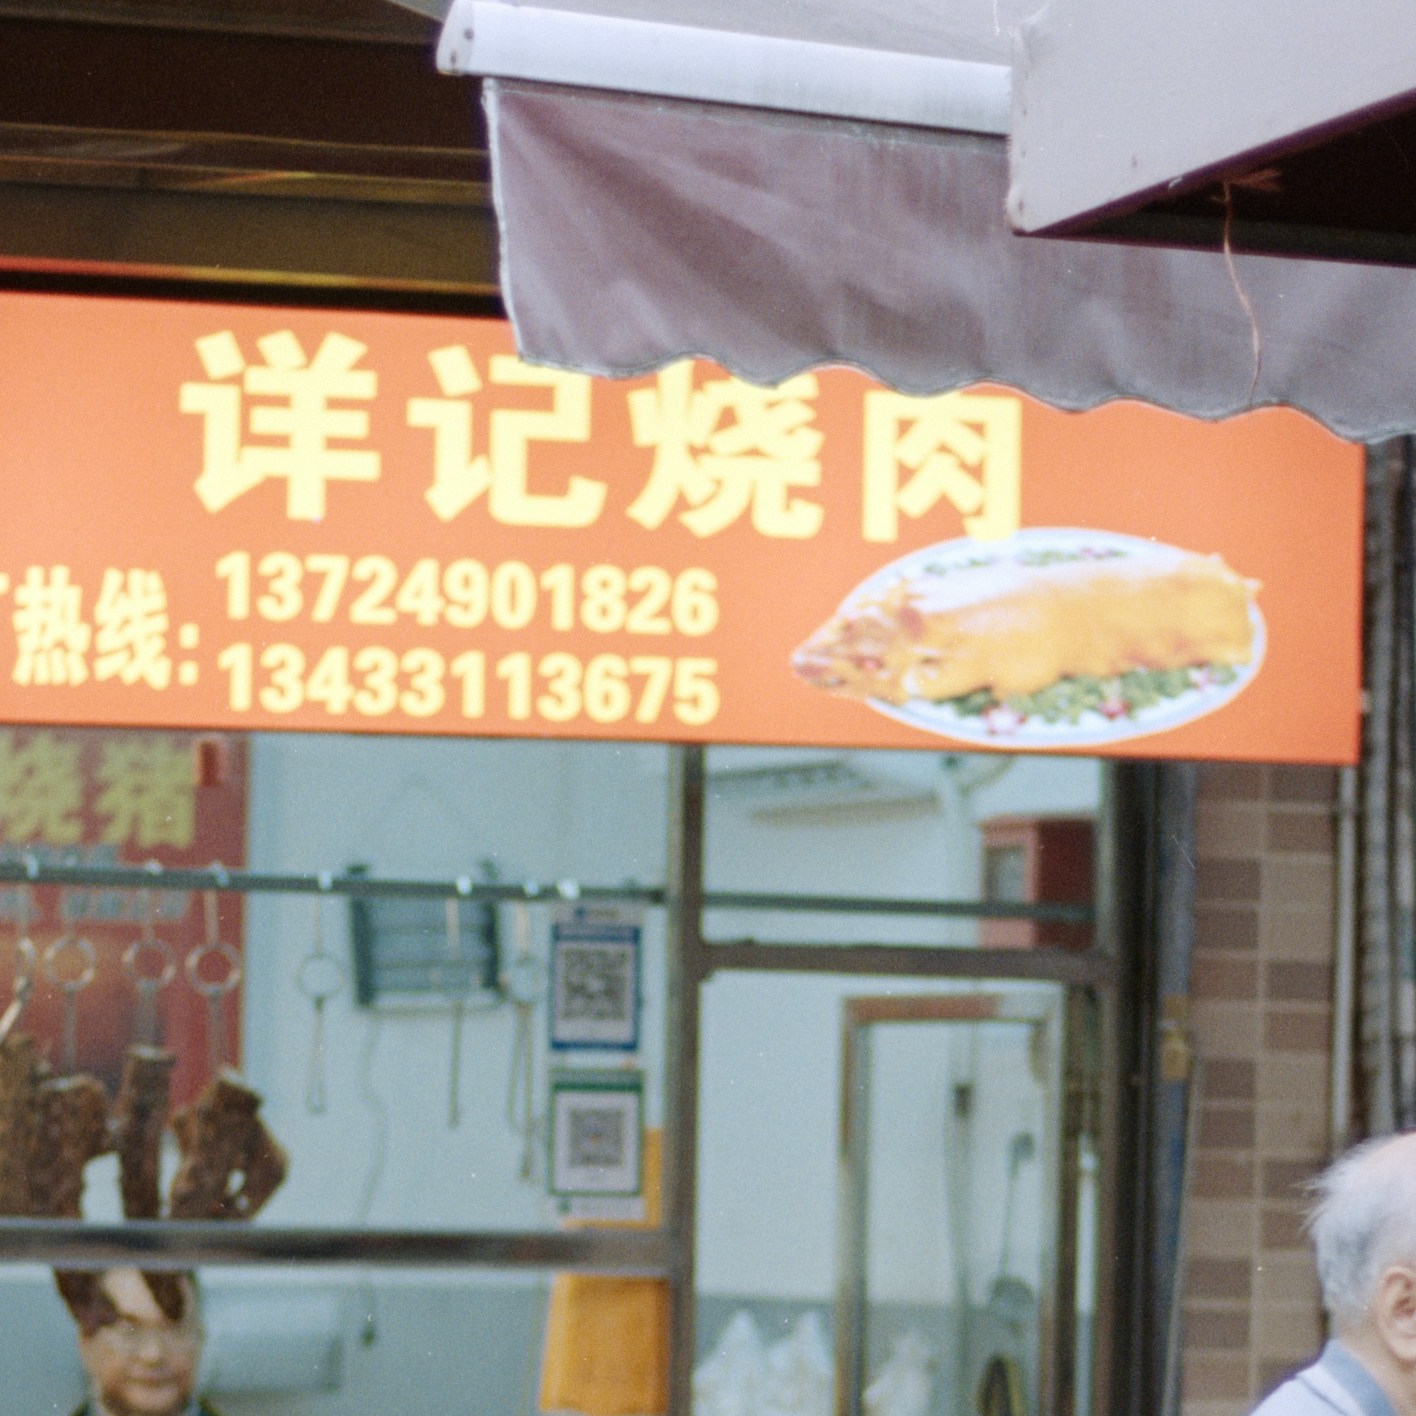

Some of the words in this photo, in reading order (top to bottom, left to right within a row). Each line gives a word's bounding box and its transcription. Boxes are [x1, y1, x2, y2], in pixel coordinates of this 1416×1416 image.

[180, 329, 1023, 543] 详记烧肉
[216, 551, 720, 636] 13724901826
[217, 642, 721, 726] 13433113675
